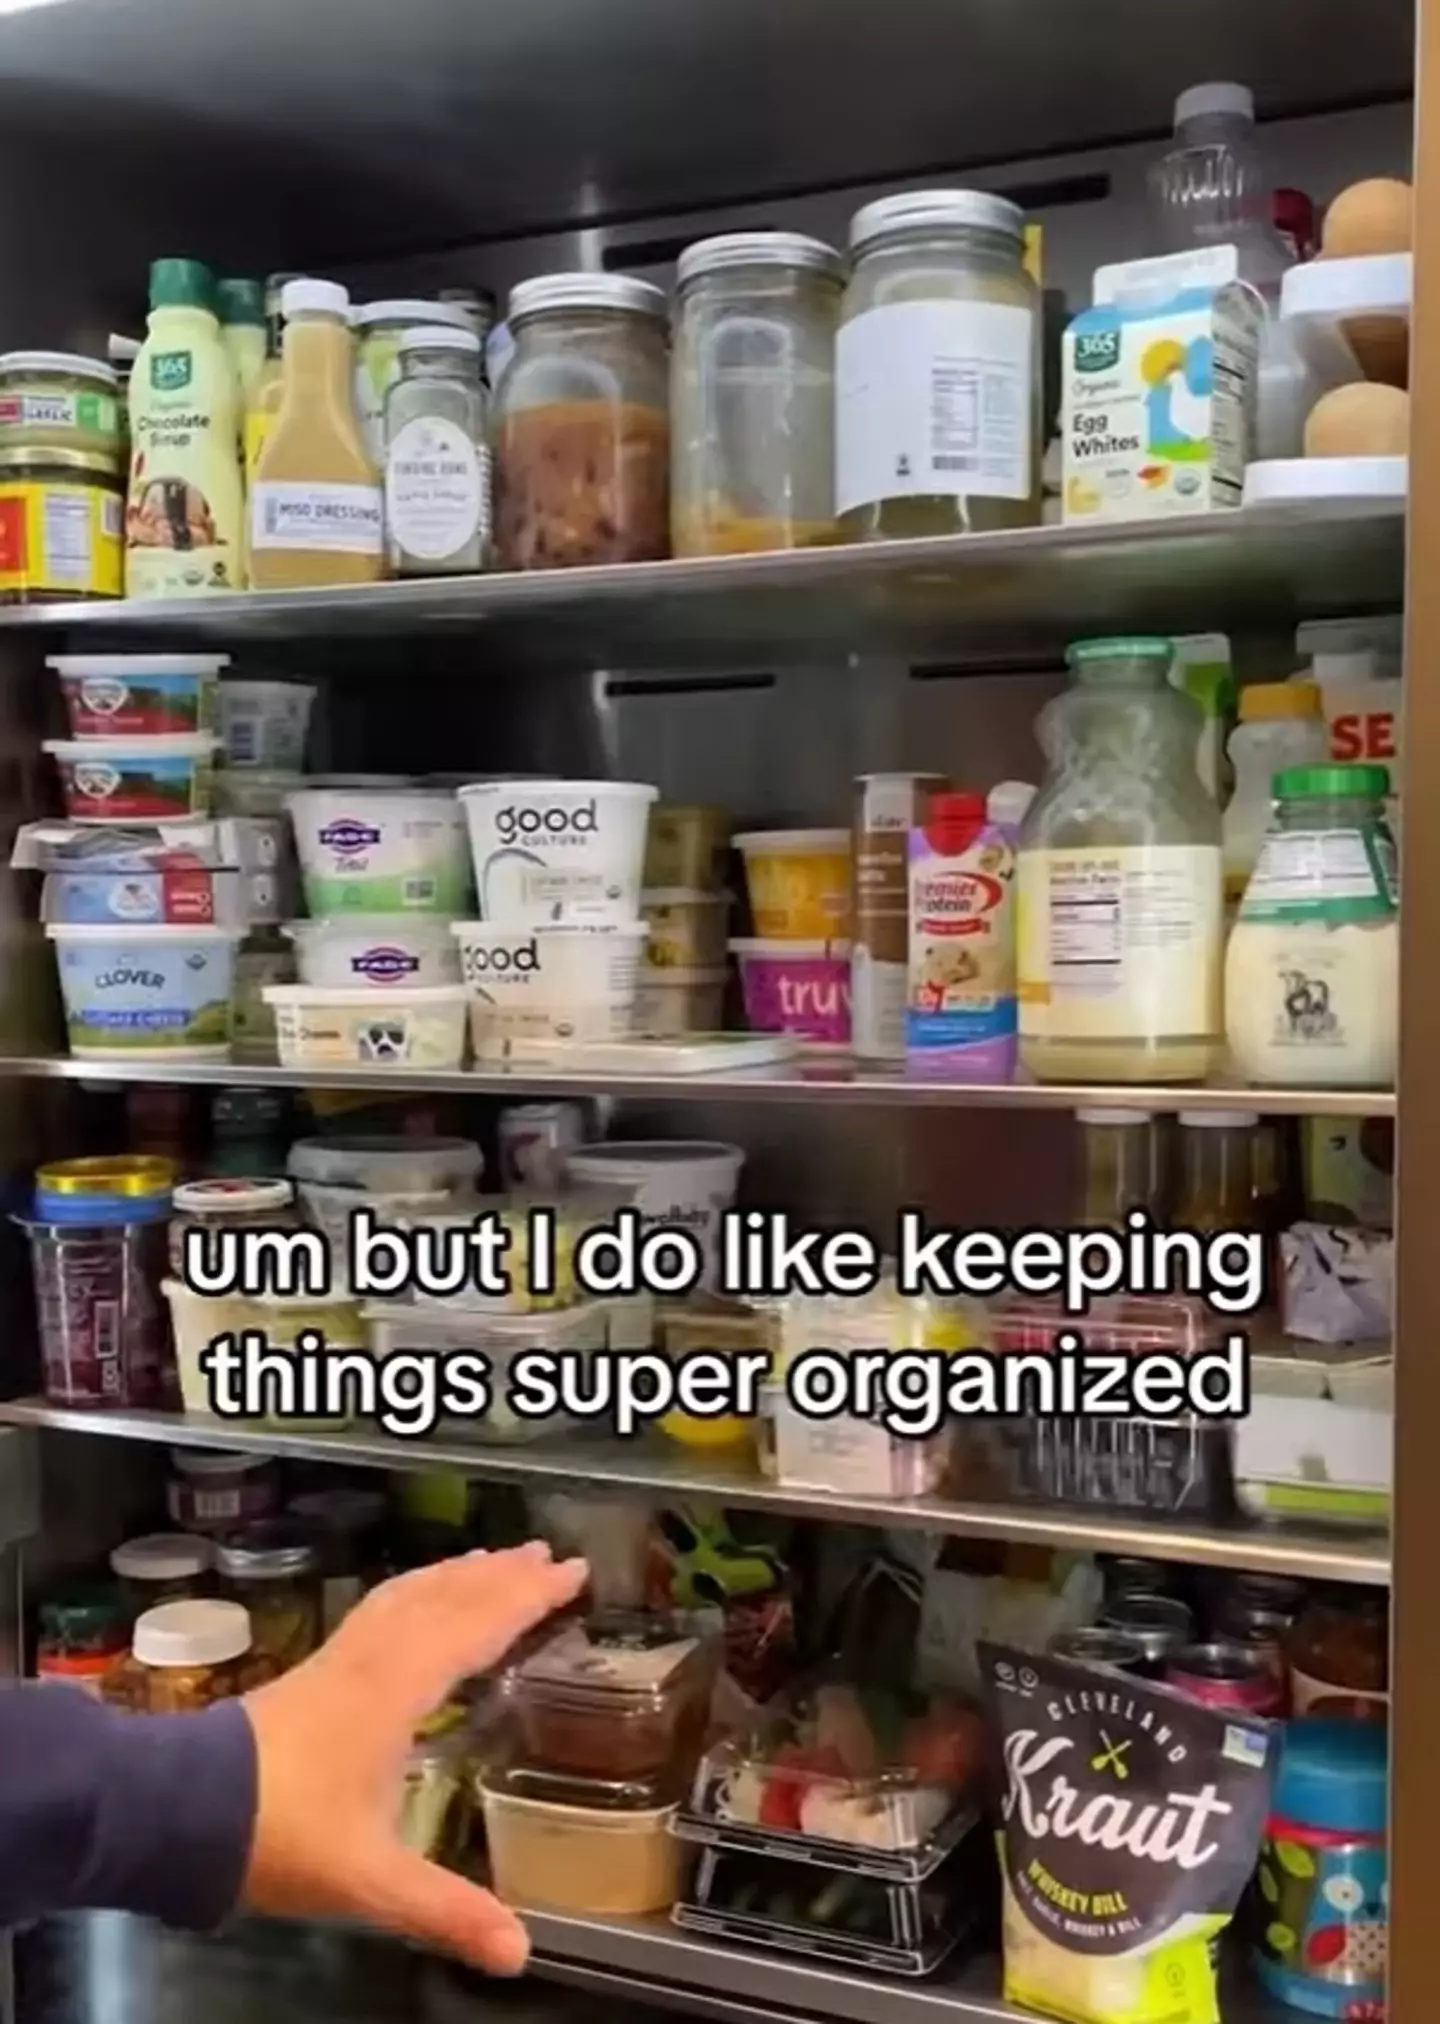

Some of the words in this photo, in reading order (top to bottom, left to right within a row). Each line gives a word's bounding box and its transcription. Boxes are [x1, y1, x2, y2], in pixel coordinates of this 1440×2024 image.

[1078, 332, 1116, 357] 365
[1072, 413, 1109, 436] Egg
[1071, 434, 1140, 457] Whites
[315, 503, 381, 523] DRESSING
[496, 797, 600, 845] good
[95, 968, 166, 990] CLOVER
[1047, 1692, 1188, 1764] CLEVELAND
[1002, 1729, 1233, 1870] Kraut
[1028, 1858, 1089, 1915] WHISKEY
[1092, 1890, 1128, 1916] DILL
